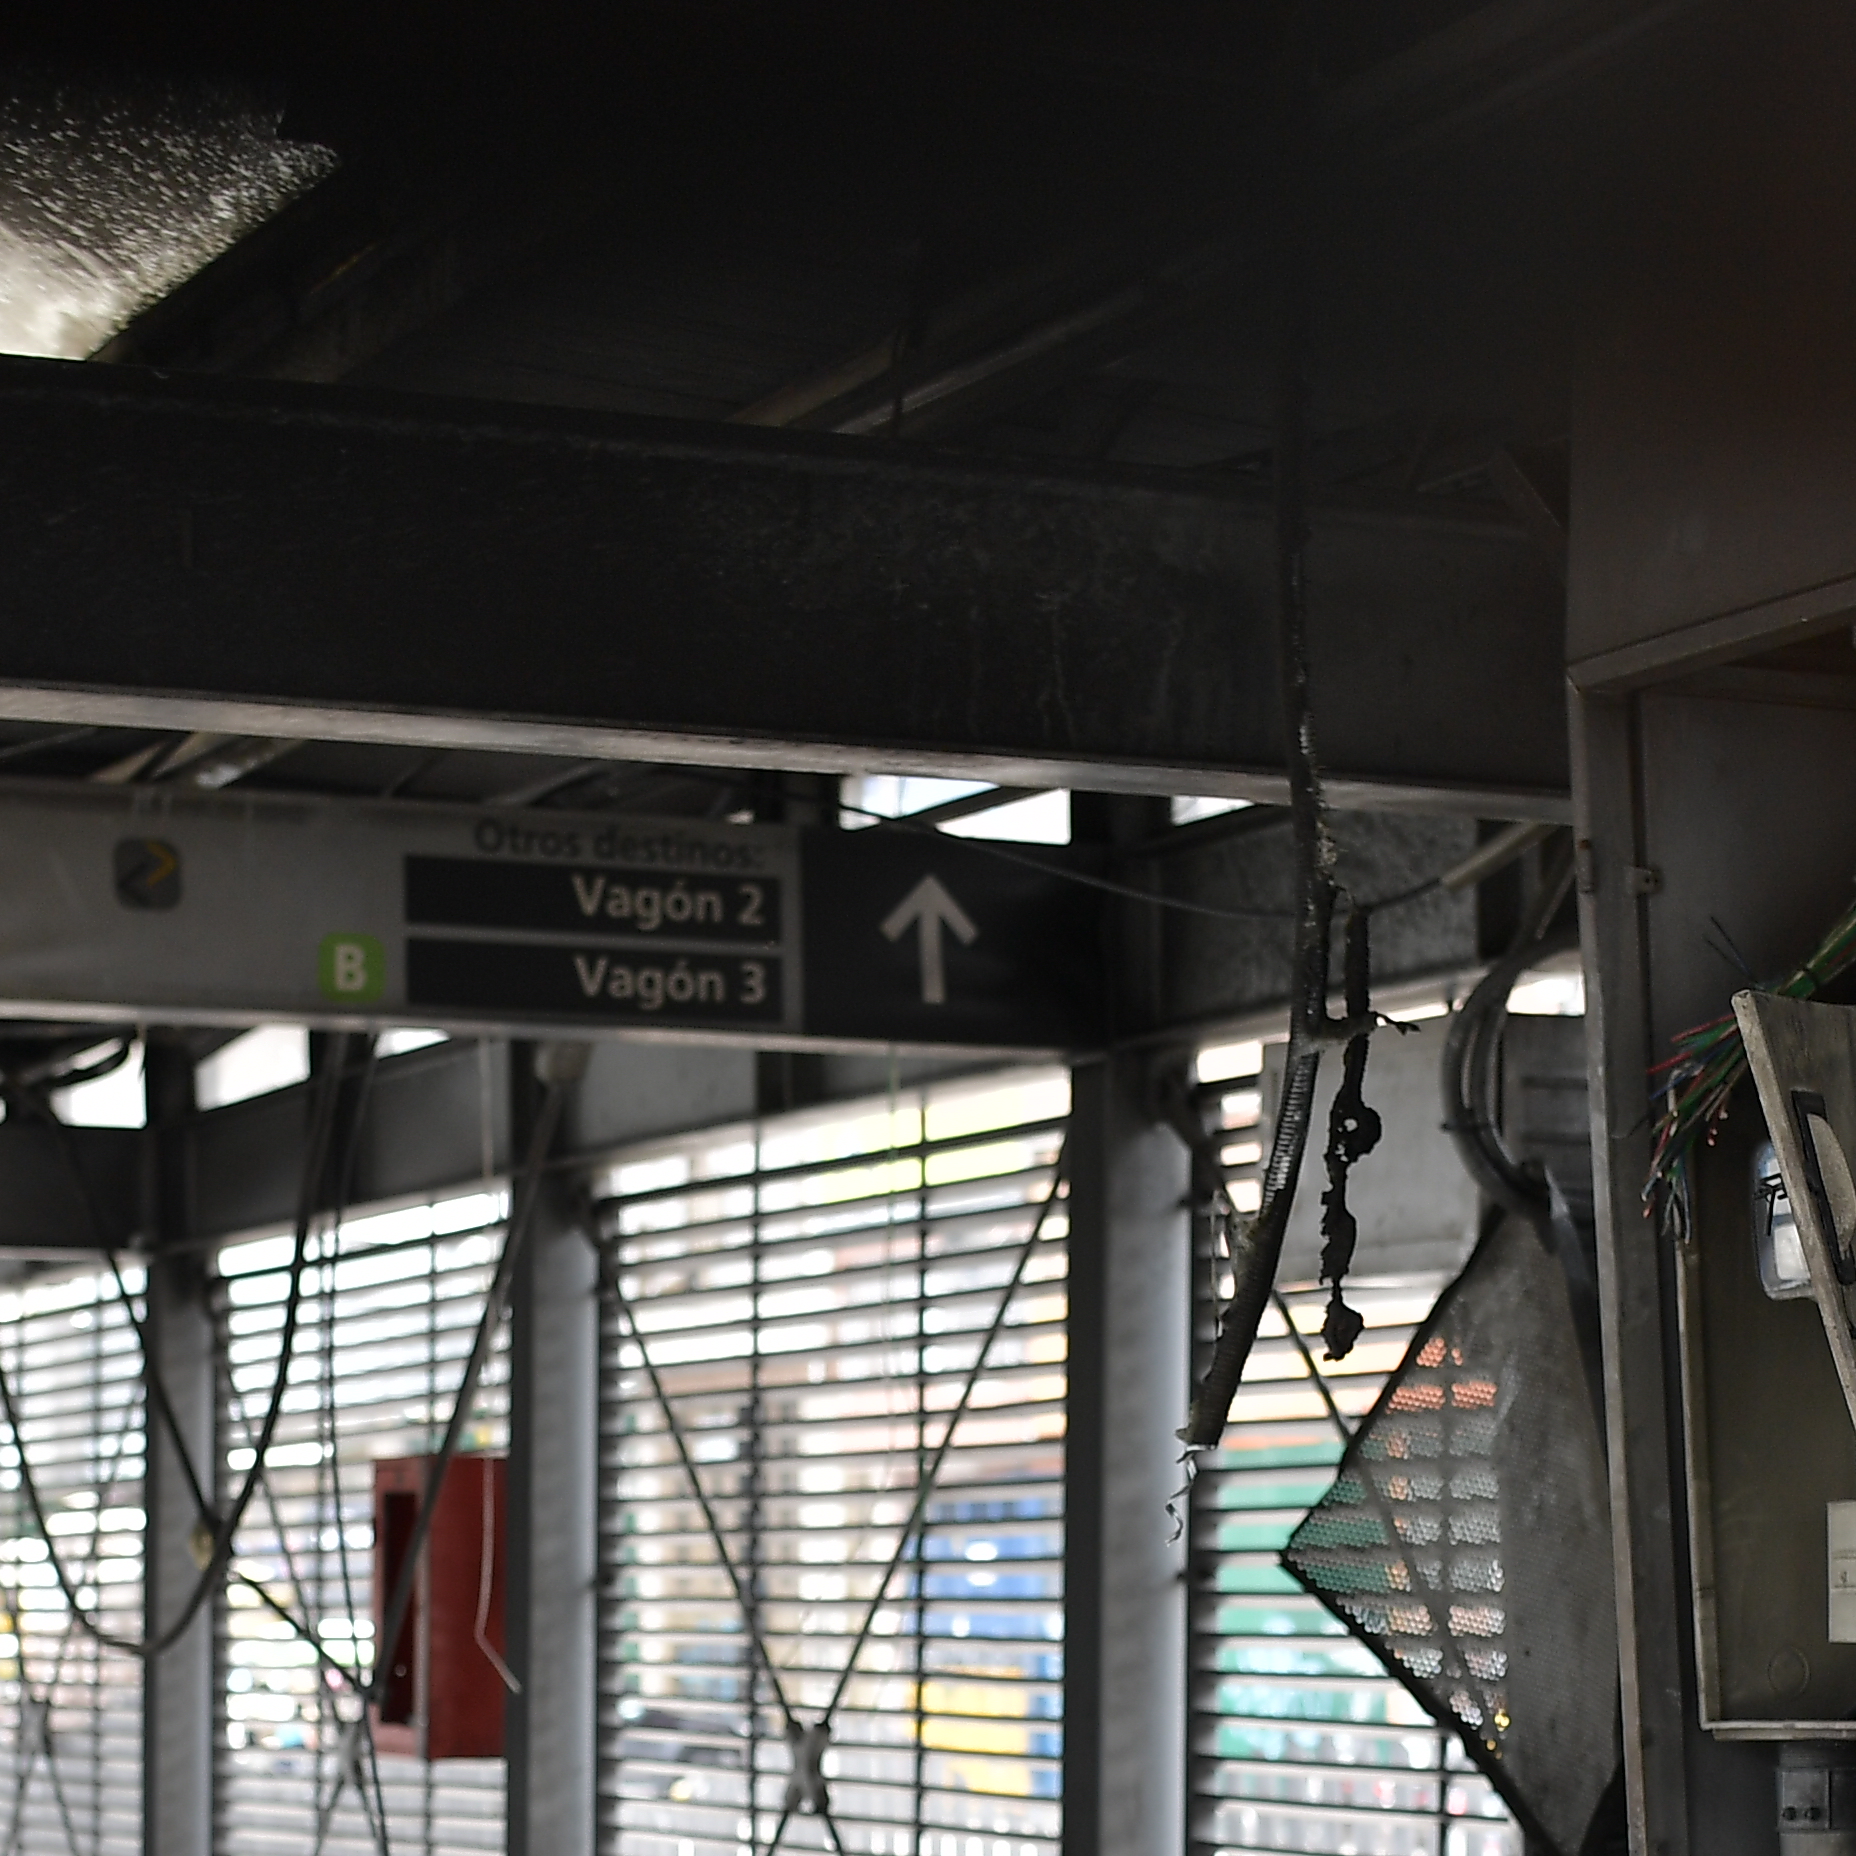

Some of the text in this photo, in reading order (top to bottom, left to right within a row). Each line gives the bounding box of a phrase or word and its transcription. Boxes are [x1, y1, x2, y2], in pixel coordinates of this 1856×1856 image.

[571, 872, 765, 932] Vagón 2
[332, 944, 366, 993] B
[574, 953, 767, 1011] Vagón 3
